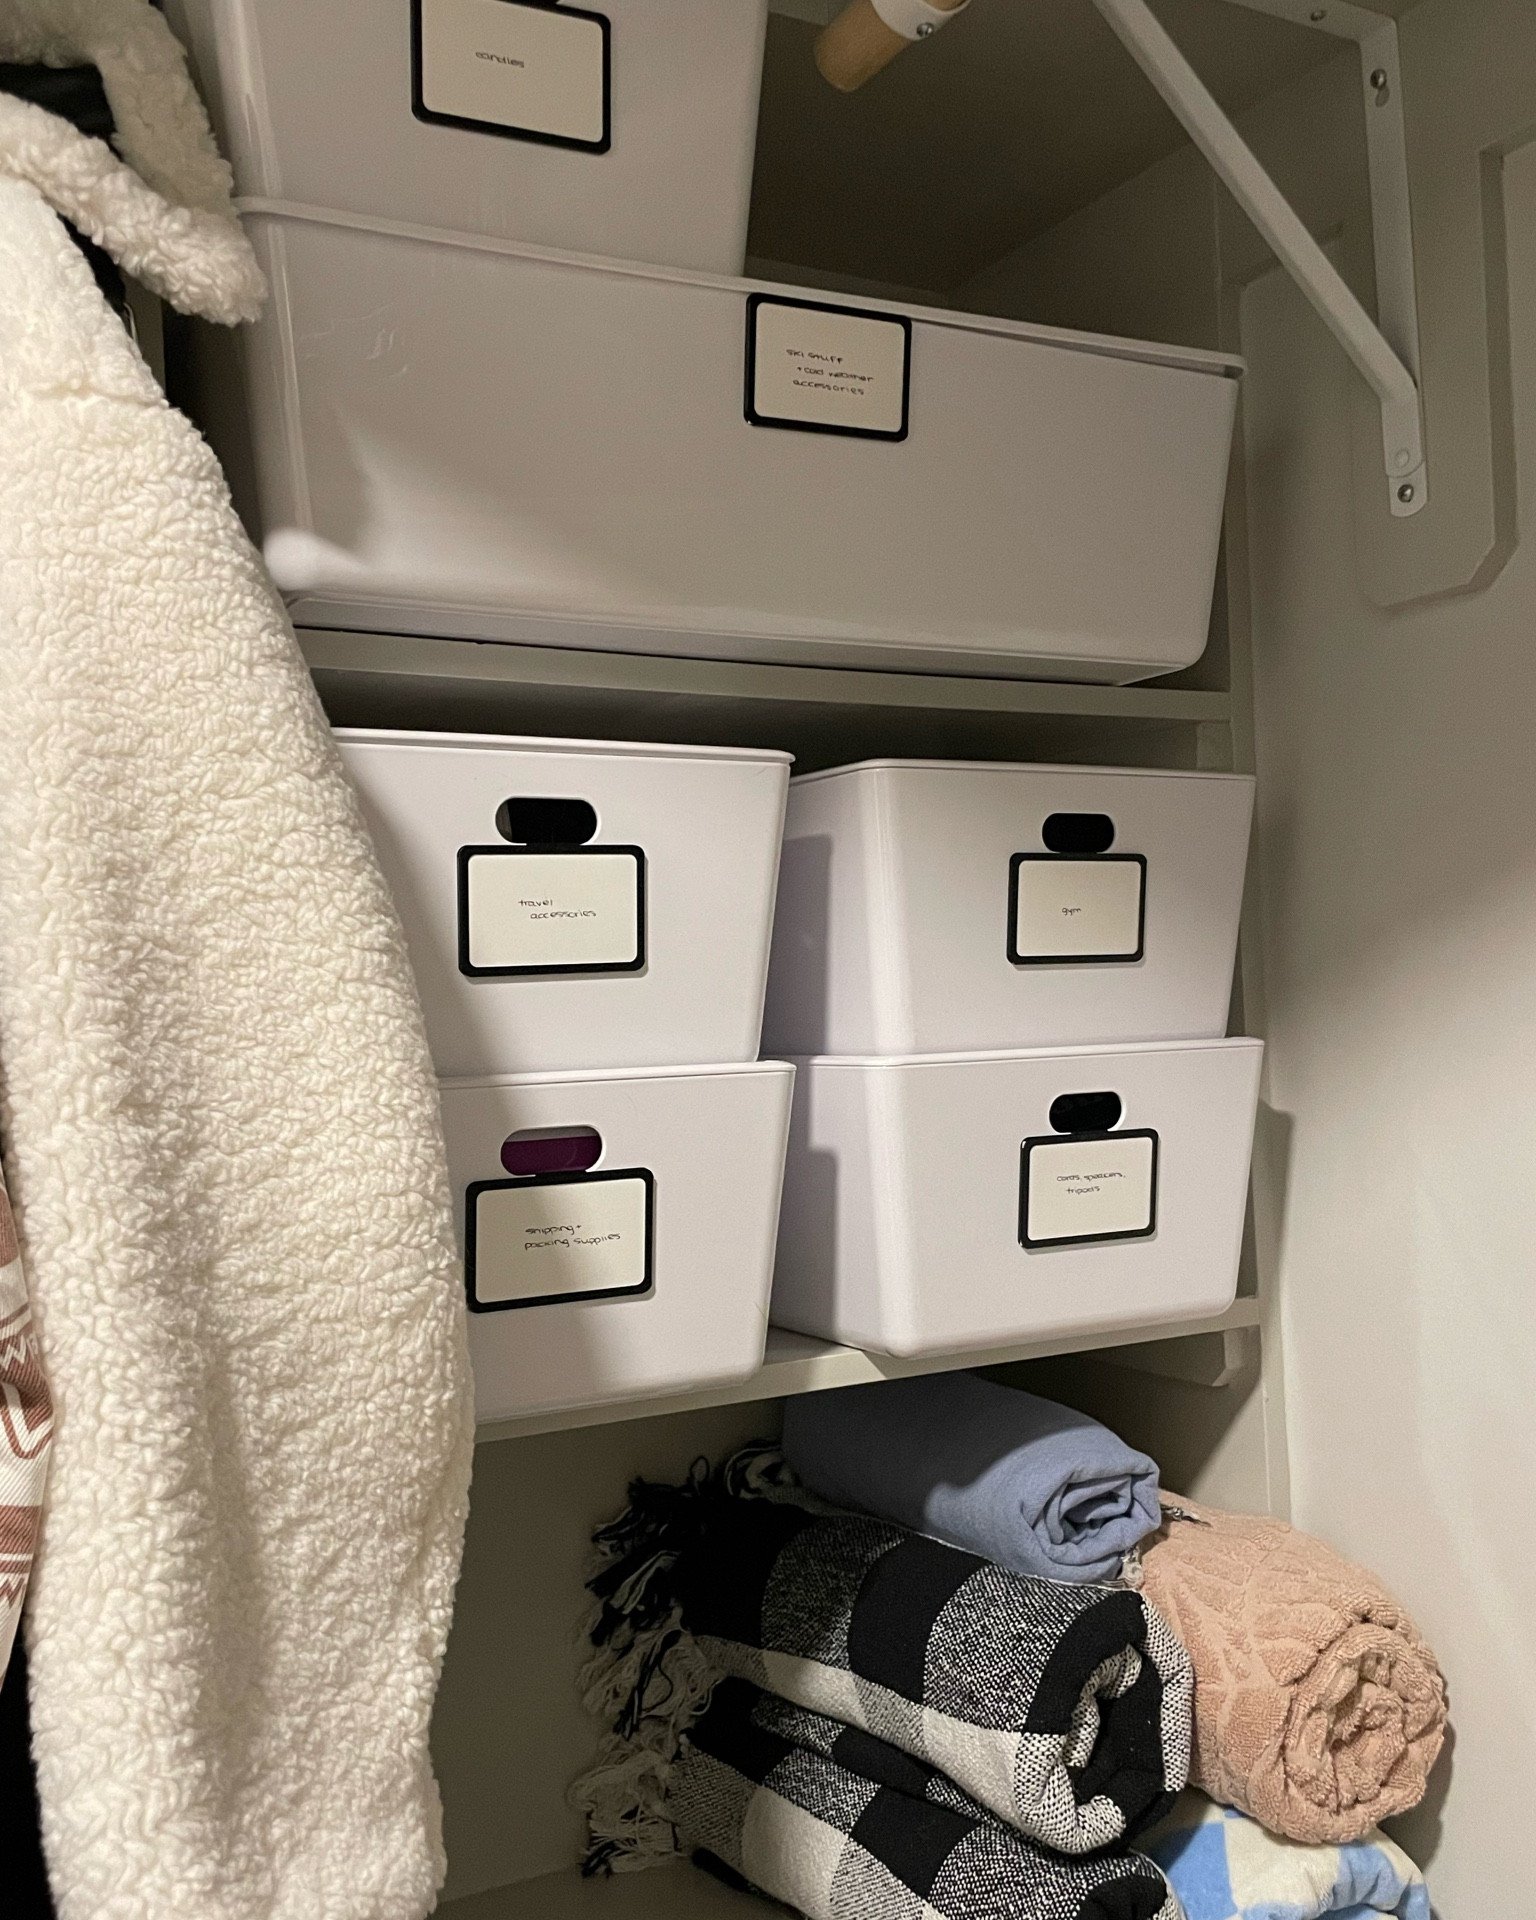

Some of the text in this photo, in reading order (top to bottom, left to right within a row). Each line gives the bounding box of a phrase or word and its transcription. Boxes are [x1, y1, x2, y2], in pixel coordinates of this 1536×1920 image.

[793, 379, 864, 396] accessories
[518, 899, 553, 907] travel
[1061, 907, 1082, 916] gym
[525, 1225, 575, 1236] shipping
[524, 1233, 621, 1251] packing supplies
